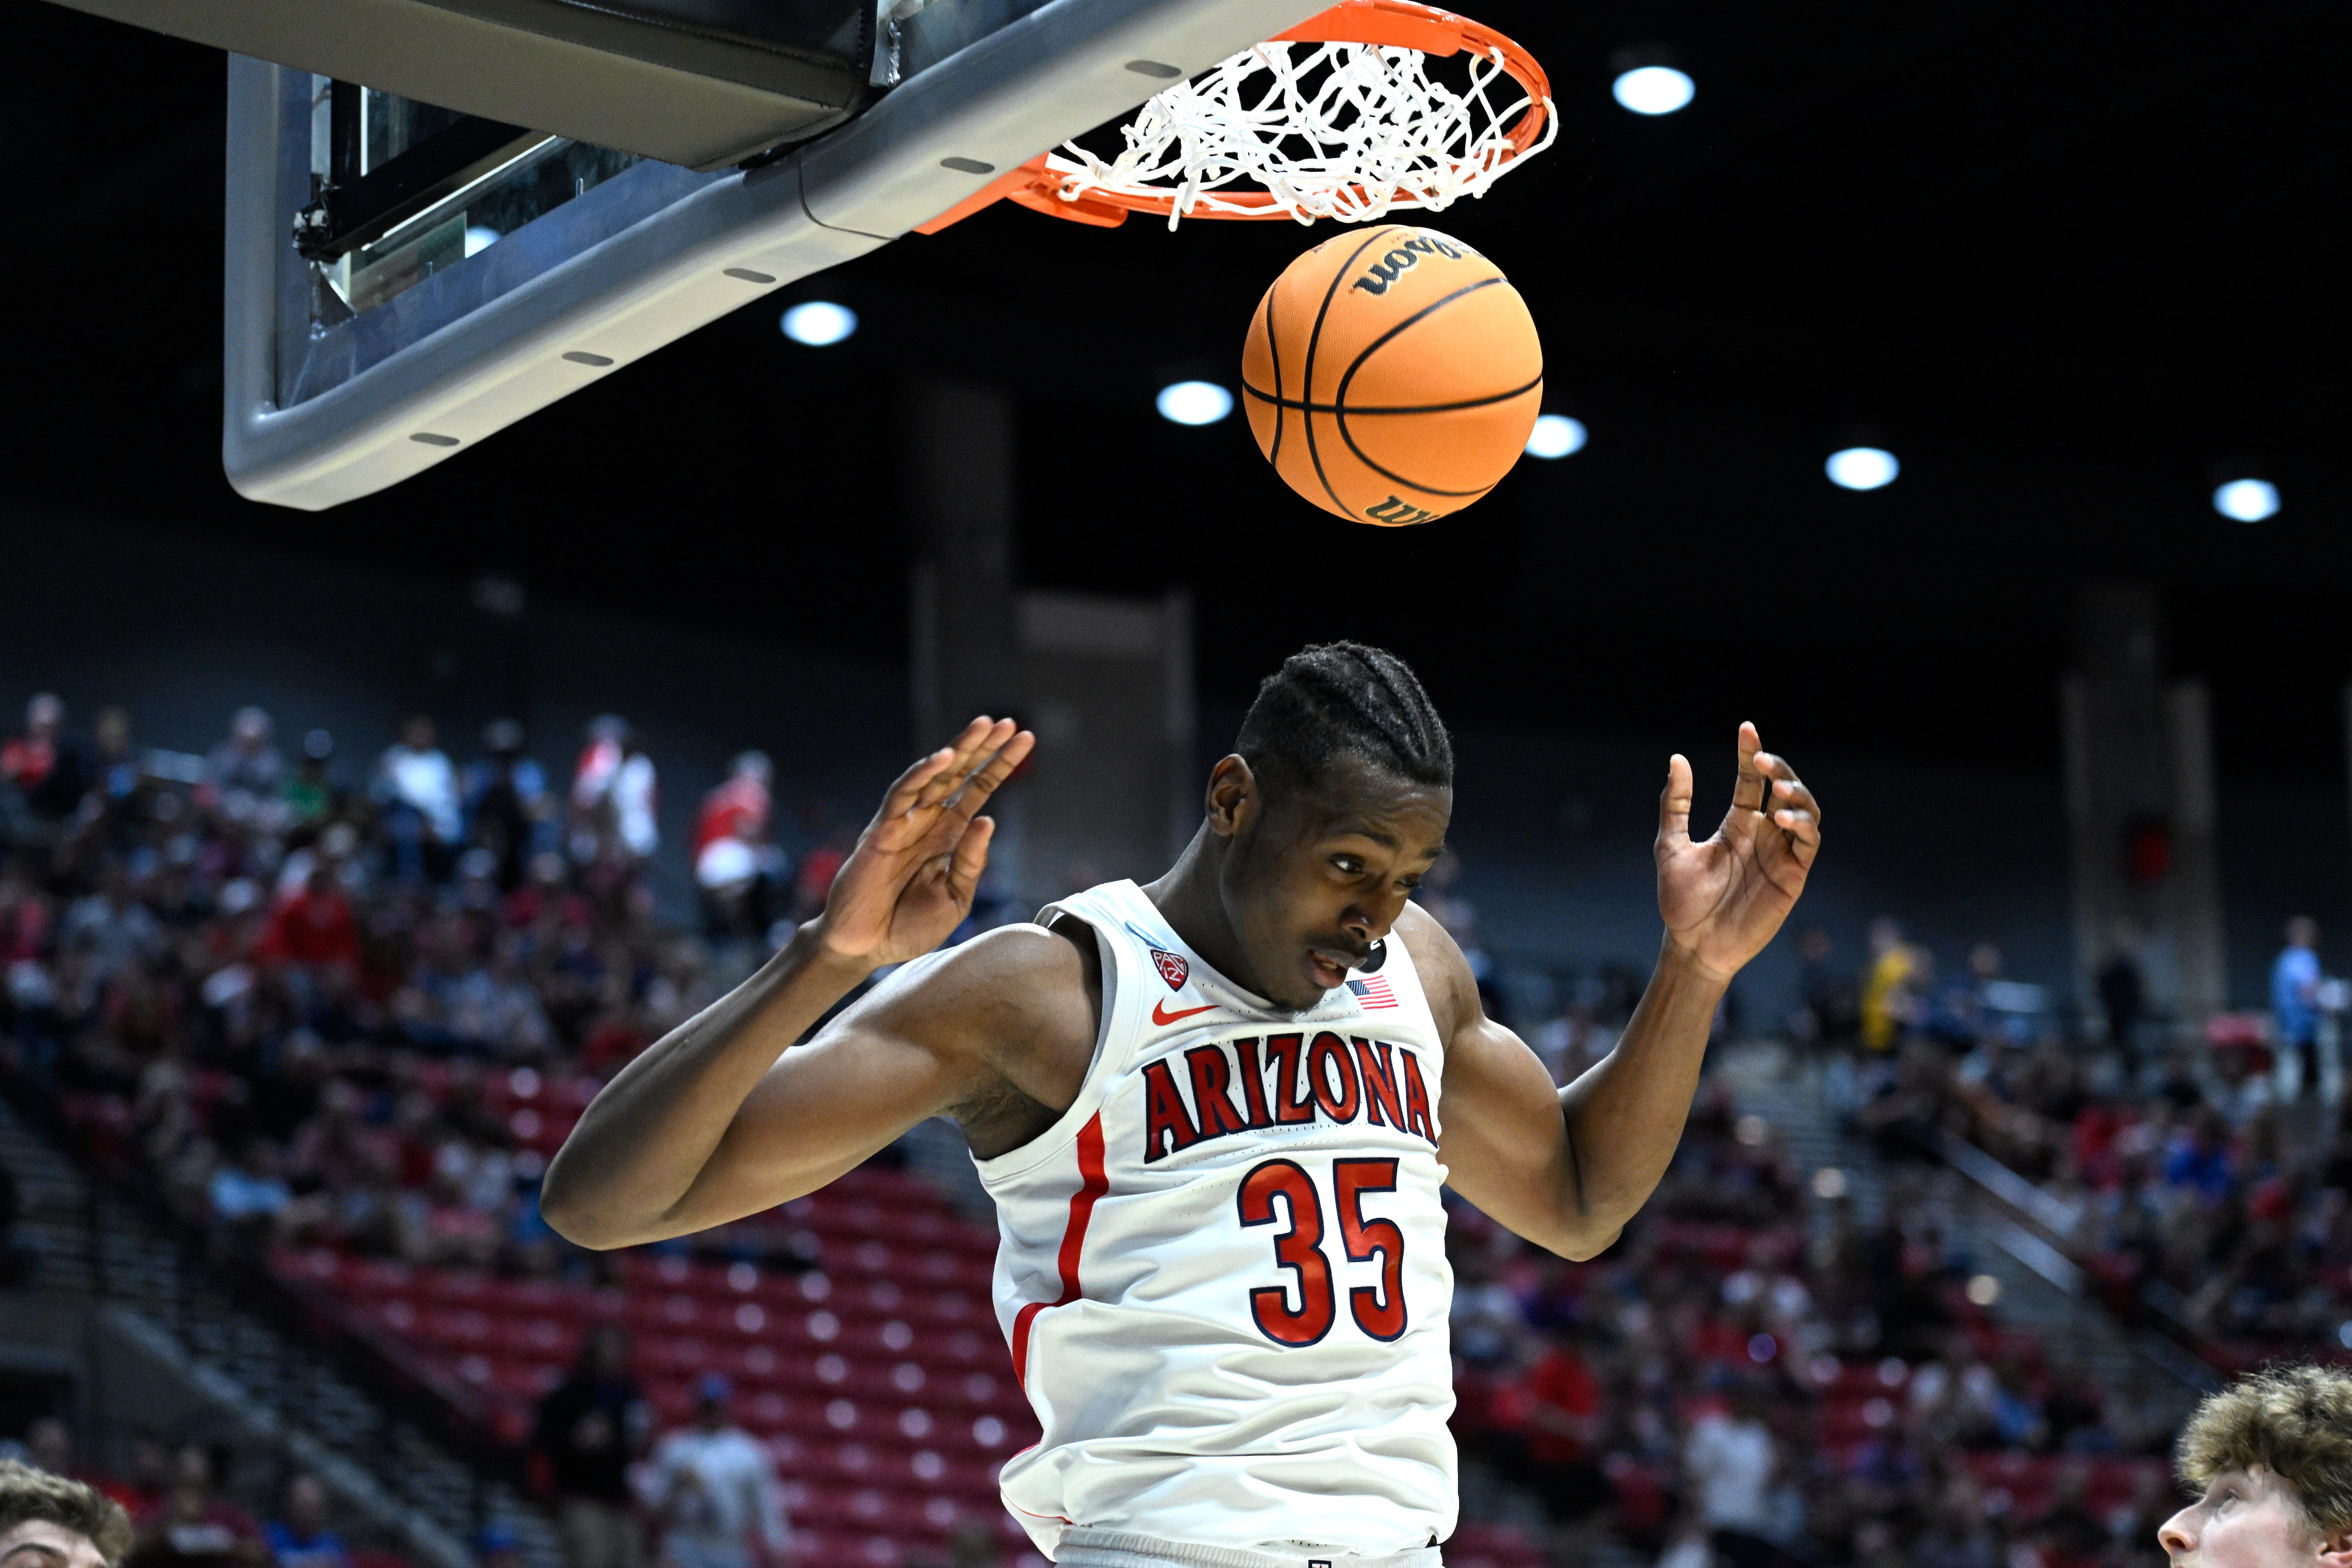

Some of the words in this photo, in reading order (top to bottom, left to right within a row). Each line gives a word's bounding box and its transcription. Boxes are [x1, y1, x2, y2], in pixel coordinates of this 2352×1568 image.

[1352, 235, 1482, 295] lson
[1153, 952, 1186, 975] PAC
[1162, 967, 1181, 981] 12
[1141, 1031, 1438, 1164] ARIZONA
[1237, 1157, 1407, 1347] 35
